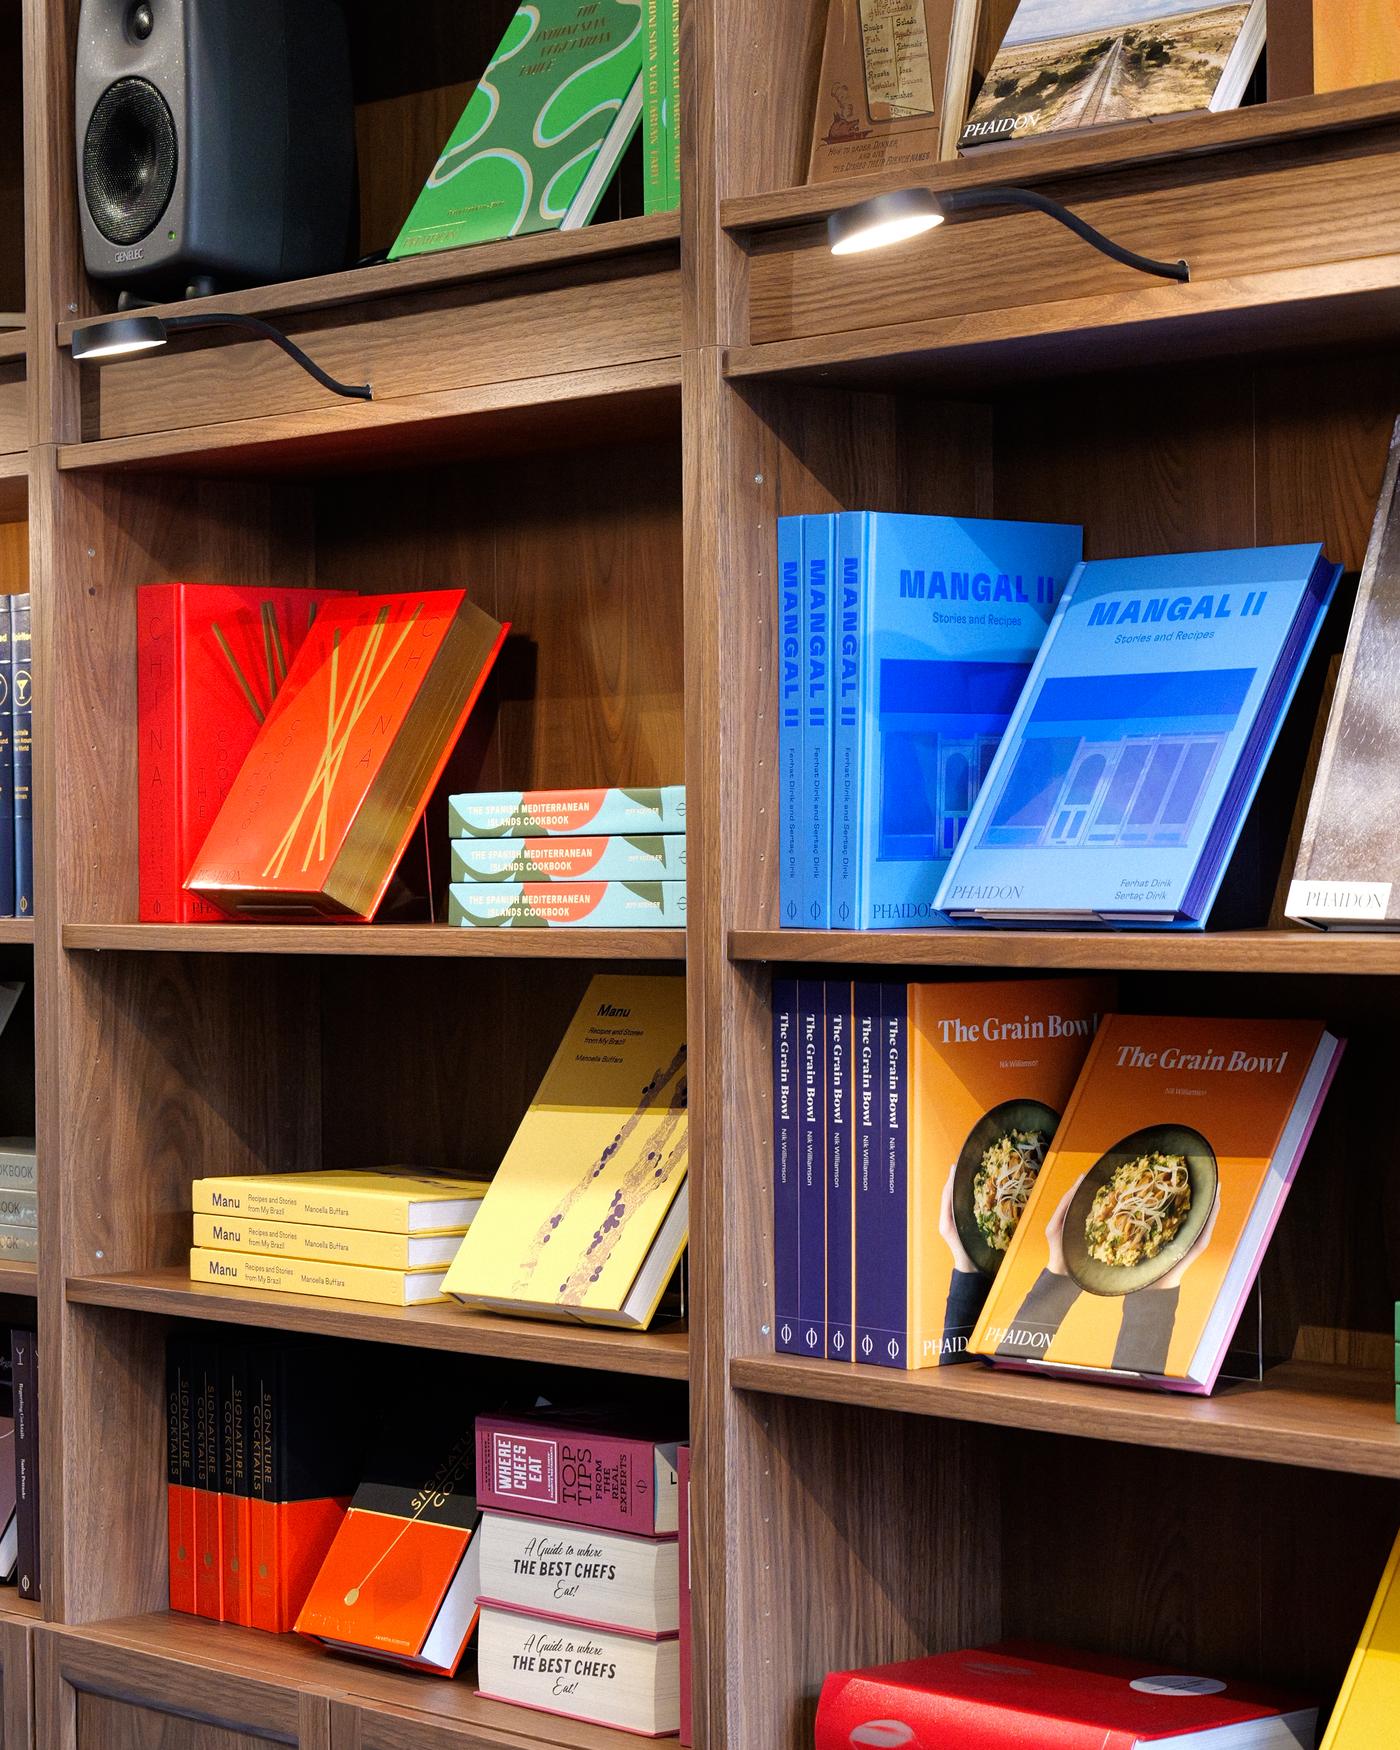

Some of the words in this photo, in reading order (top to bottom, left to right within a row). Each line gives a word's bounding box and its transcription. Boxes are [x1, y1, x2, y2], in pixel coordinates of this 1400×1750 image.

[963, 114, 1040, 137] PHAIDON
[114, 248, 144, 263] GENELEC
[900, 570, 1028, 603] MANGAL
[1037, 576, 1054, 604] II
[933, 612, 967, 624] Stories
[969, 614, 985, 625] and
[988, 613, 1022, 627] Recipes
[1087, 594, 1231, 626] MANGAL
[1240, 591, 1267, 617] II
[784, 561, 799, 699] MANGAL
[810, 559, 826, 698] MANGAL
[841, 558, 858, 697] MANGAL
[1114, 633, 1151, 645] Stories
[1154, 631, 1174, 642] and
[1175, 630, 1215, 641] Recipes
[355, 616, 440, 769] CHINA
[785, 708, 799, 727] II
[810, 707, 824, 726] II
[841, 707, 856, 726] II
[469, 806, 484, 814] THE
[486, 804, 519, 814] SPANISH
[521, 802, 590, 813] MEDITERRANEAN
[487, 817, 521, 826] ISLANDS
[523, 815, 569, 826] COOKBOOK
[471, 851, 486, 860] THE
[488, 849, 521, 860] SPANISH
[524, 848, 592, 859] MEDITERRANEAN
[490, 862, 524, 872] ISLANDS
[526, 861, 572, 871] COOKBOOK
[951, 885, 1024, 899] PHAIDON
[1120, 879, 1150, 887] Ferhat
[1151, 879, 1172, 887] Dirik
[469, 896, 484, 905] THE
[486, 895, 519, 905] SPANISH
[522, 894, 591, 905] MEDITERRANEAN
[1114, 891, 1144, 901] Sertaç
[1145, 890, 1167, 900] Dirik
[1306, 891, 1385, 908] PHAIDON
[488, 908, 522, 917] ISLANDS
[524, 907, 570, 917] COOKBOOK
[596, 1004, 631, 1017] Manu
[780, 1013, 789, 1040] The
[806, 1014, 815, 1041] The
[834, 1015, 842, 1042] The
[862, 1017, 871, 1044] The
[889, 1018, 898, 1046] The
[937, 1018, 980, 1044] The
[983, 1015, 1044, 1041] Grain
[1048, 1012, 1098, 1038] Bowl
[780, 1041, 789, 1082] Grain
[806, 1044, 815, 1084] Grain
[834, 1044, 842, 1086] Grain
[862, 1046, 871, 1088] Grain
[889, 1048, 898, 1090] Grain
[1116, 1046, 1157, 1068] The
[1159, 1048, 1224, 1071] Grain
[1227, 1050, 1289, 1073] Bowl
[780, 1085, 789, 1120] Bowl
[806, 1087, 815, 1122] Bowl
[834, 1089, 842, 1124] Bowl
[862, 1091, 871, 1127] Bowl
[889, 1093, 898, 1128] Bowl
[212, 1192, 240, 1209] Manu
[248, 1194, 267, 1204] Recipes
[279, 1197, 297, 1206] Stories
[248, 1206, 259, 1214] from
[260, 1206, 269, 1216] My
[269, 1207, 284, 1216] Brazil
[304, 1205, 327, 1214] Manoella
[328, 1207, 349, 1217] Buffara
[213, 1226, 240, 1242] Manu
[248, 1239, 260, 1247] from
[260, 1240, 269, 1249] My
[270, 1241, 285, 1250] Brazil
[249, 1228, 268, 1238] Recipes
[278, 1231, 297, 1240] Stories
[304, 1239, 328, 1249] Manoella
[329, 1242, 349, 1251] Buffara
[209, 1261, 237, 1277] Manu
[245, 1262, 264, 1273] Recipes
[275, 1266, 294, 1275] Stories
[245, 1274, 256, 1282] from
[257, 1275, 266, 1284] My
[266, 1276, 281, 1285] Brazil
[301, 1275, 324, 1285] Manoella
[325, 1277, 345, 1287] Buffara
[985, 1327, 1057, 1349] PHAIDON
[170, 1392, 178, 1475] COCKTAILS
[181, 1381, 190, 1468] SIGNATURE
[235, 1389, 243, 1478] SIGNATURE
[197, 1397, 205, 1480] COCKTAILS
[224, 1401, 232, 1485] COCKTAILS
[264, 1394, 272, 1483] SIGNATURE
[498, 1439, 512, 1489] WHERE
[513, 1444, 527, 1489] CHEFS
[528, 1455, 542, 1482] EAT
[562, 1445, 577, 1504] TOP
[577, 1448, 592, 1506] TIPS
[603, 1467, 611, 1494] THE
[524, 1537, 536, 1557] A
[536, 1538, 563, 1561] Guide
[565, 1544, 574, 1555] to
[576, 1543, 603, 1557] where
[513, 1559, 537, 1575] THE
[539, 1561, 572, 1577] BEST
[574, 1563, 616, 1580] CHEFS
[553, 1580, 579, 1599] Eat!
[523, 1634, 536, 1653] A
[536, 1634, 563, 1658] Guide
[565, 1641, 574, 1652] to
[576, 1641, 603, 1656] where
[512, 1655, 536, 1671] THE
[538, 1657, 572, 1674] BEST
[574, 1660, 617, 1679] CHEFS
[552, 1676, 578, 1696] Eat!
